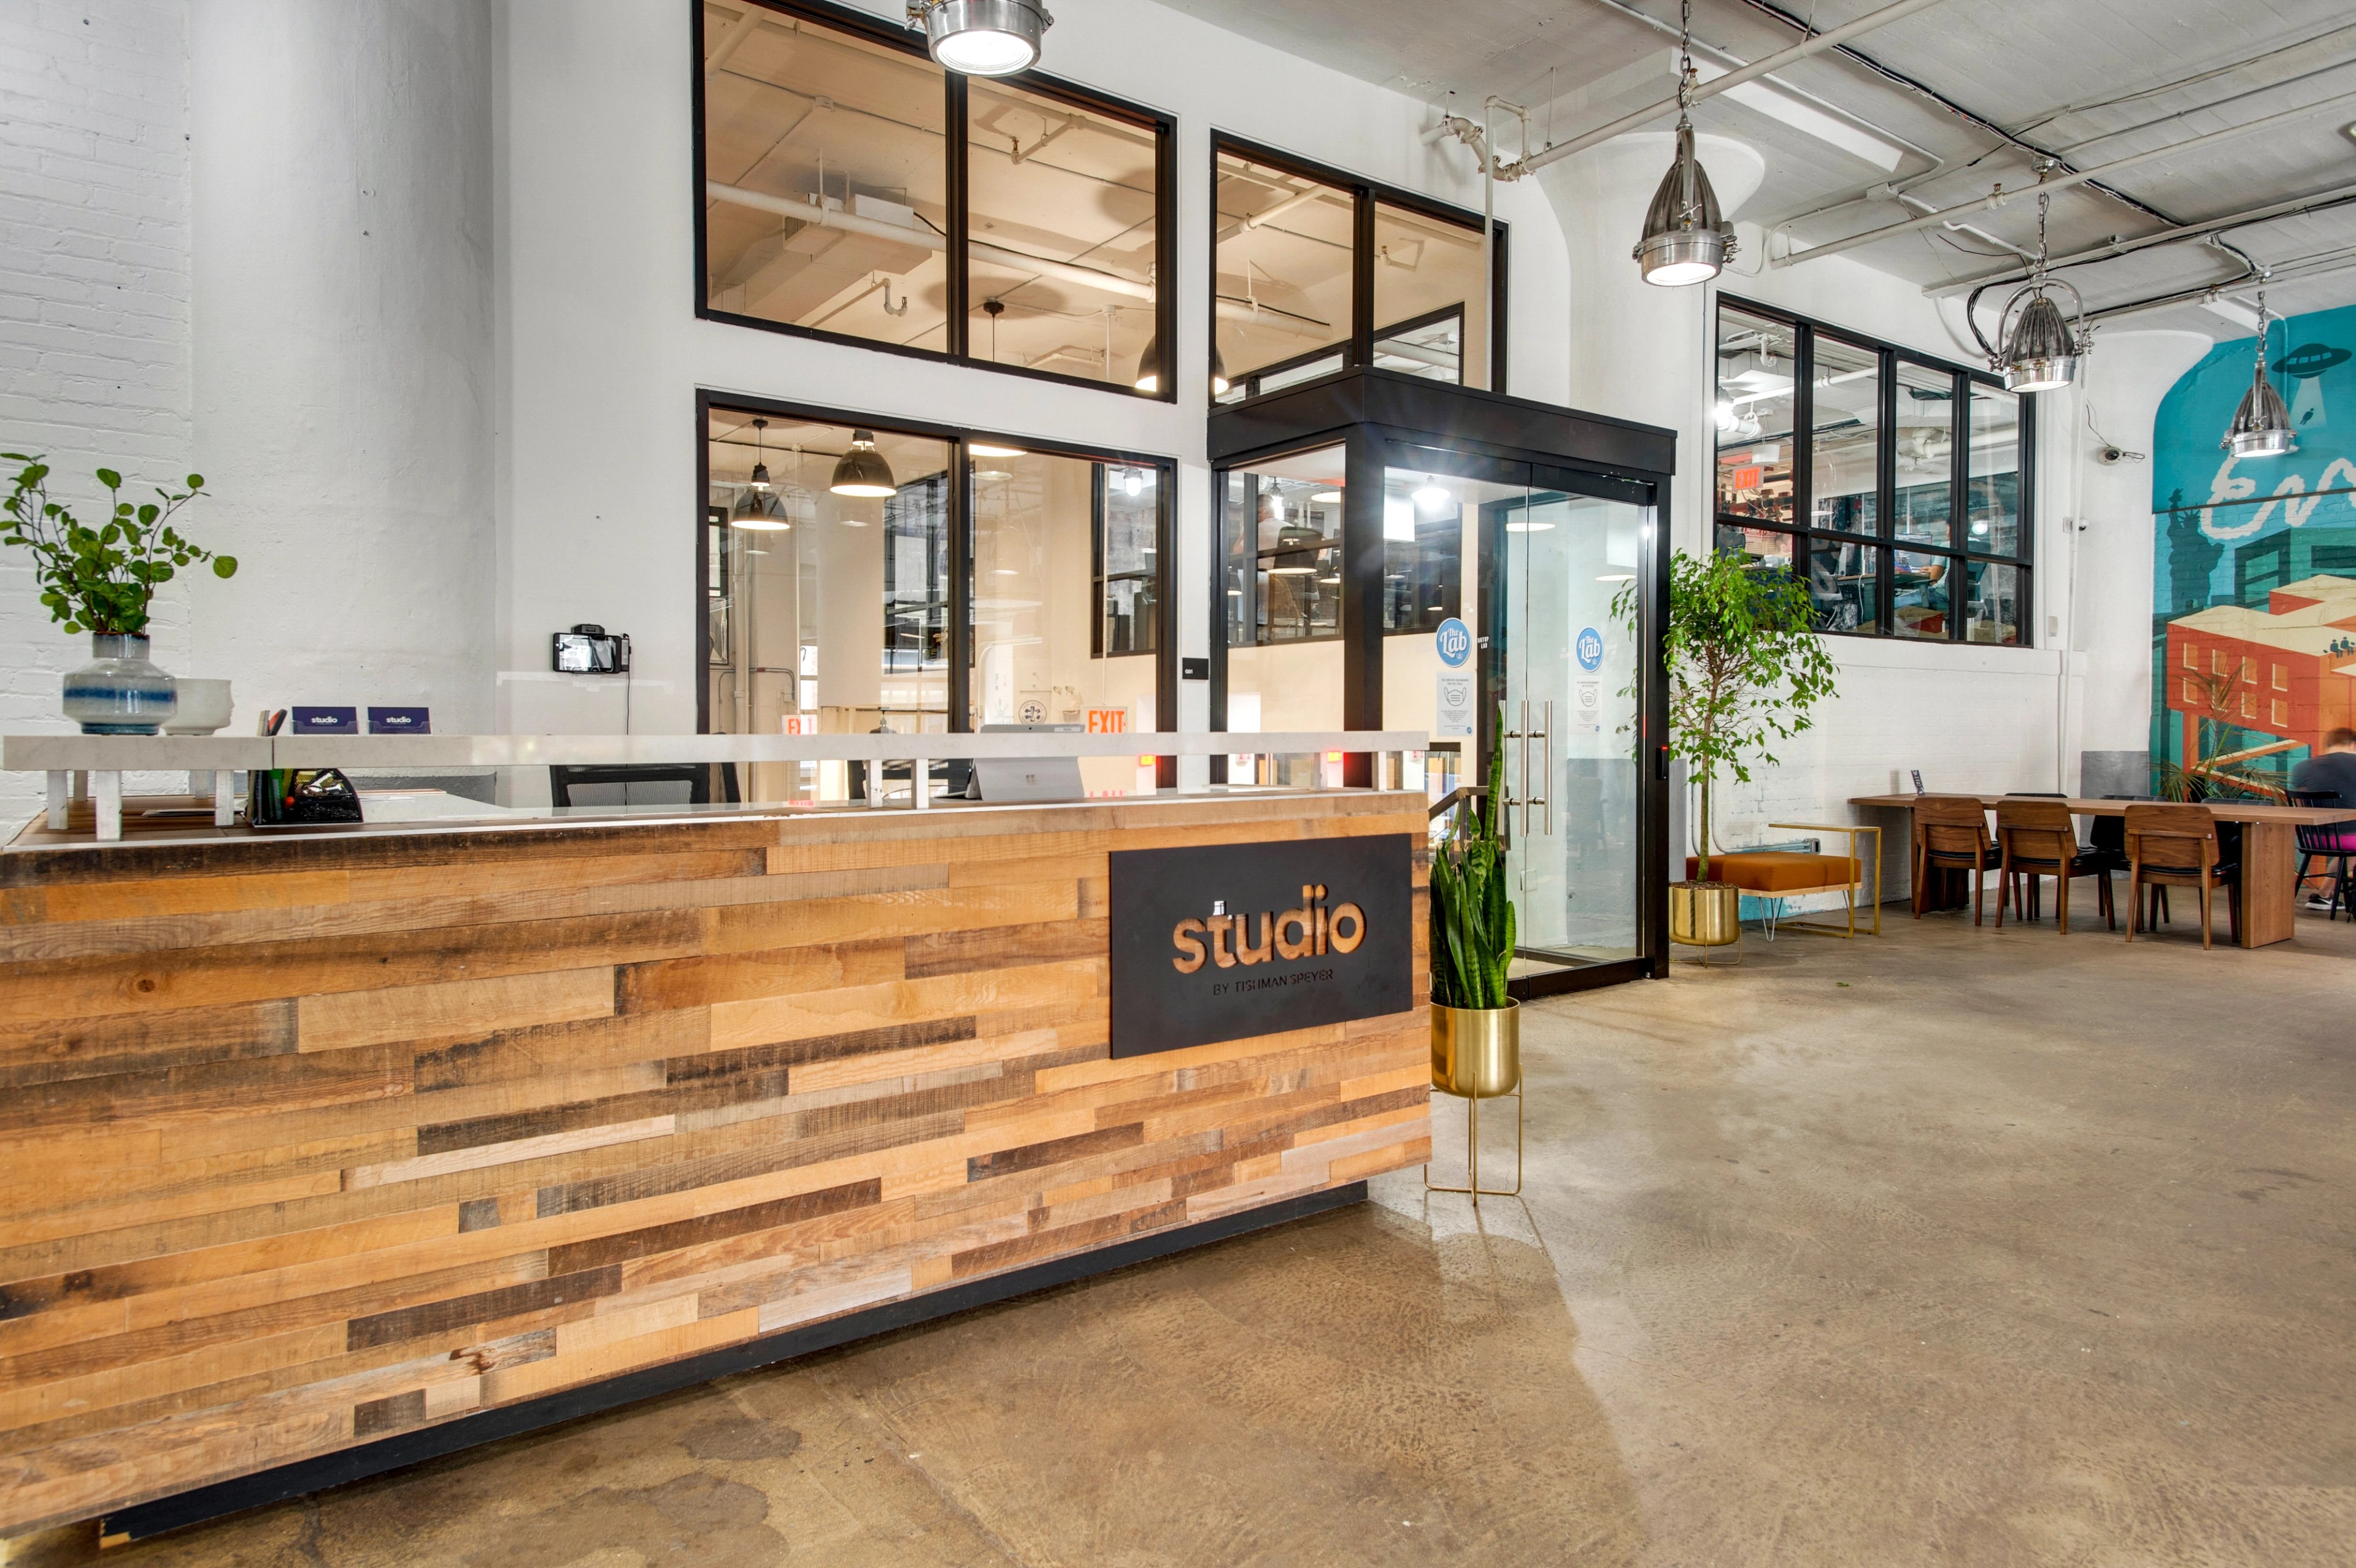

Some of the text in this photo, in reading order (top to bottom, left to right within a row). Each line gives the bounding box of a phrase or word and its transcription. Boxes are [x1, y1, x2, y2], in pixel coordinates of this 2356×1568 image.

[1735, 467, 1760, 489] EXIT
[1440, 631, 1467, 658] Lab
[1579, 639, 1600, 663] Lab
[788, 718, 813, 735] EXT
[1088, 710, 1124, 734] EXIT
[1172, 884, 1368, 974] studio
[1213, 969, 1334, 996] BY TISHMAN SPEYER
